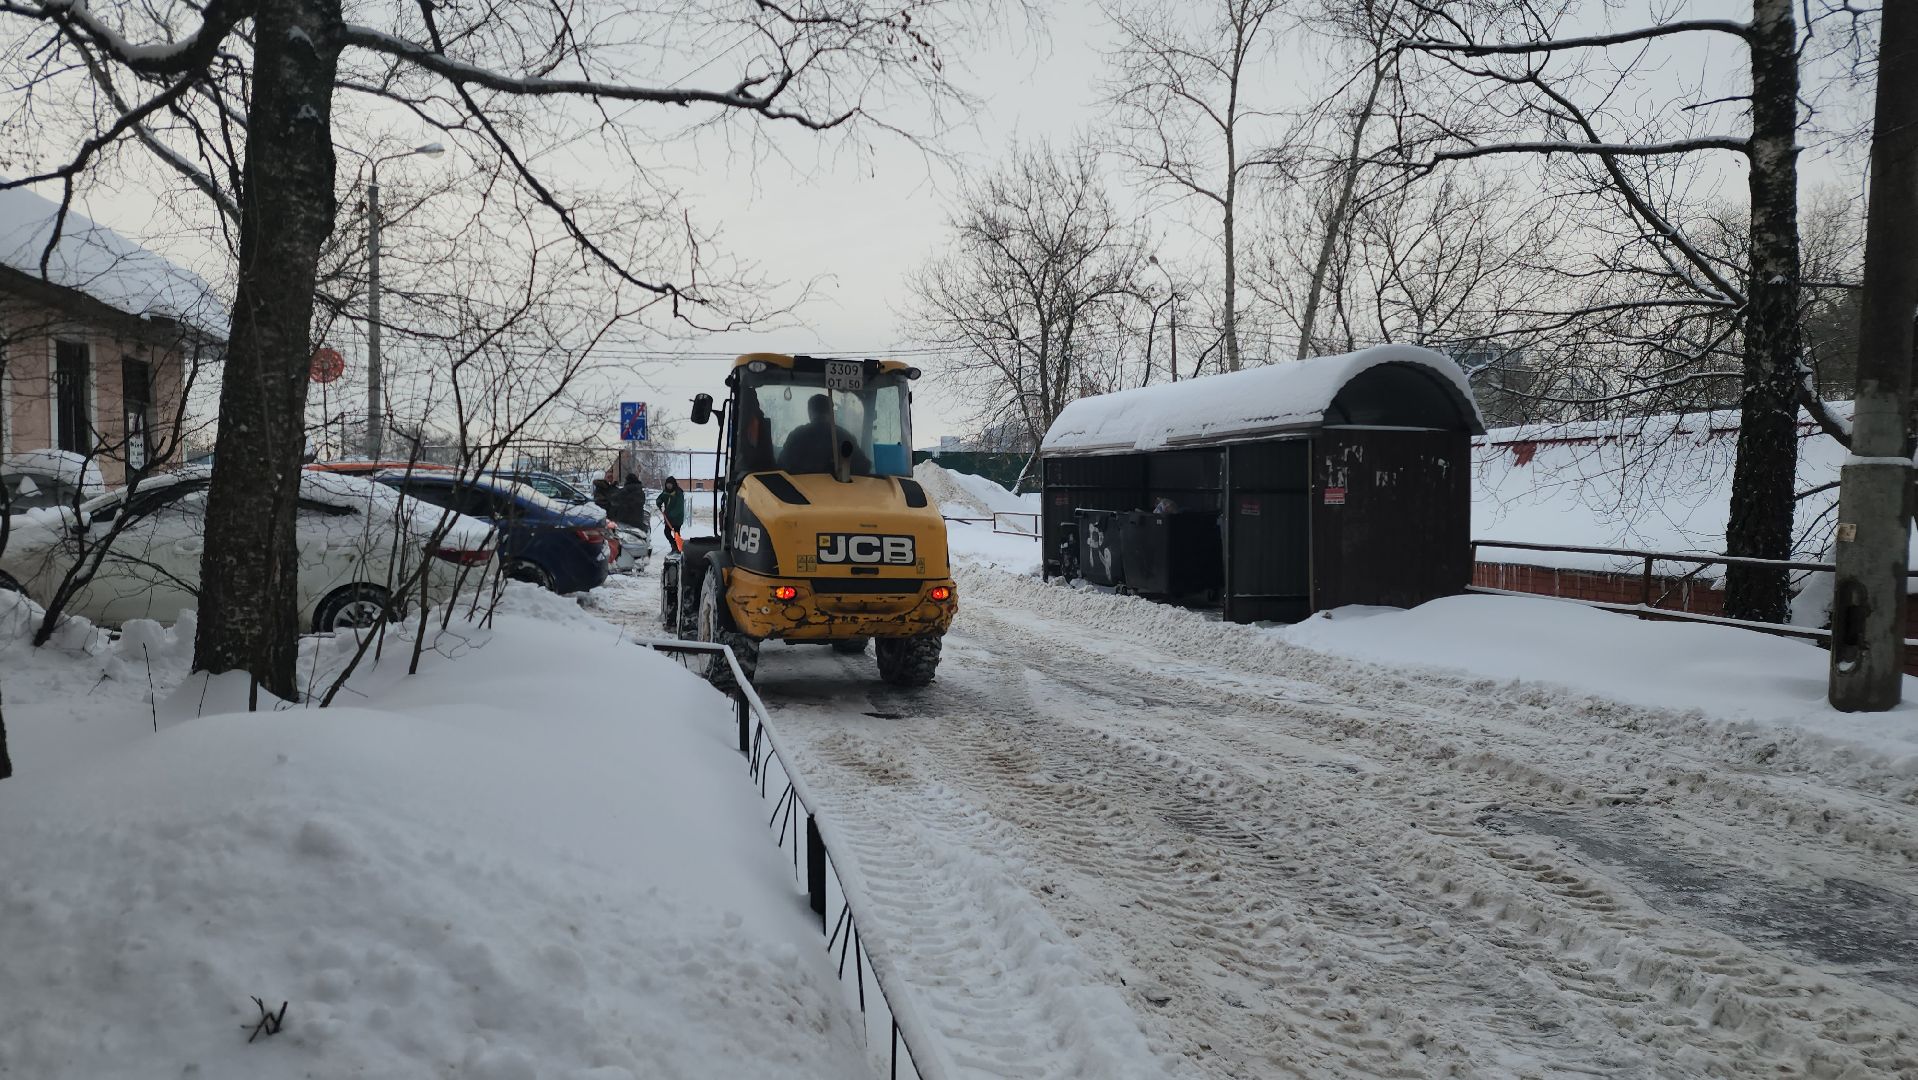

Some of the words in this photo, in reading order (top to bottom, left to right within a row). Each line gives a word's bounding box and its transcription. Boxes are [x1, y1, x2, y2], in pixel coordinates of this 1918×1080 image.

[830, 363, 858, 376] 3309
[849, 379, 860, 389] 50
[733, 523, 761, 554] JCB
[819, 535, 914, 564] JCB
